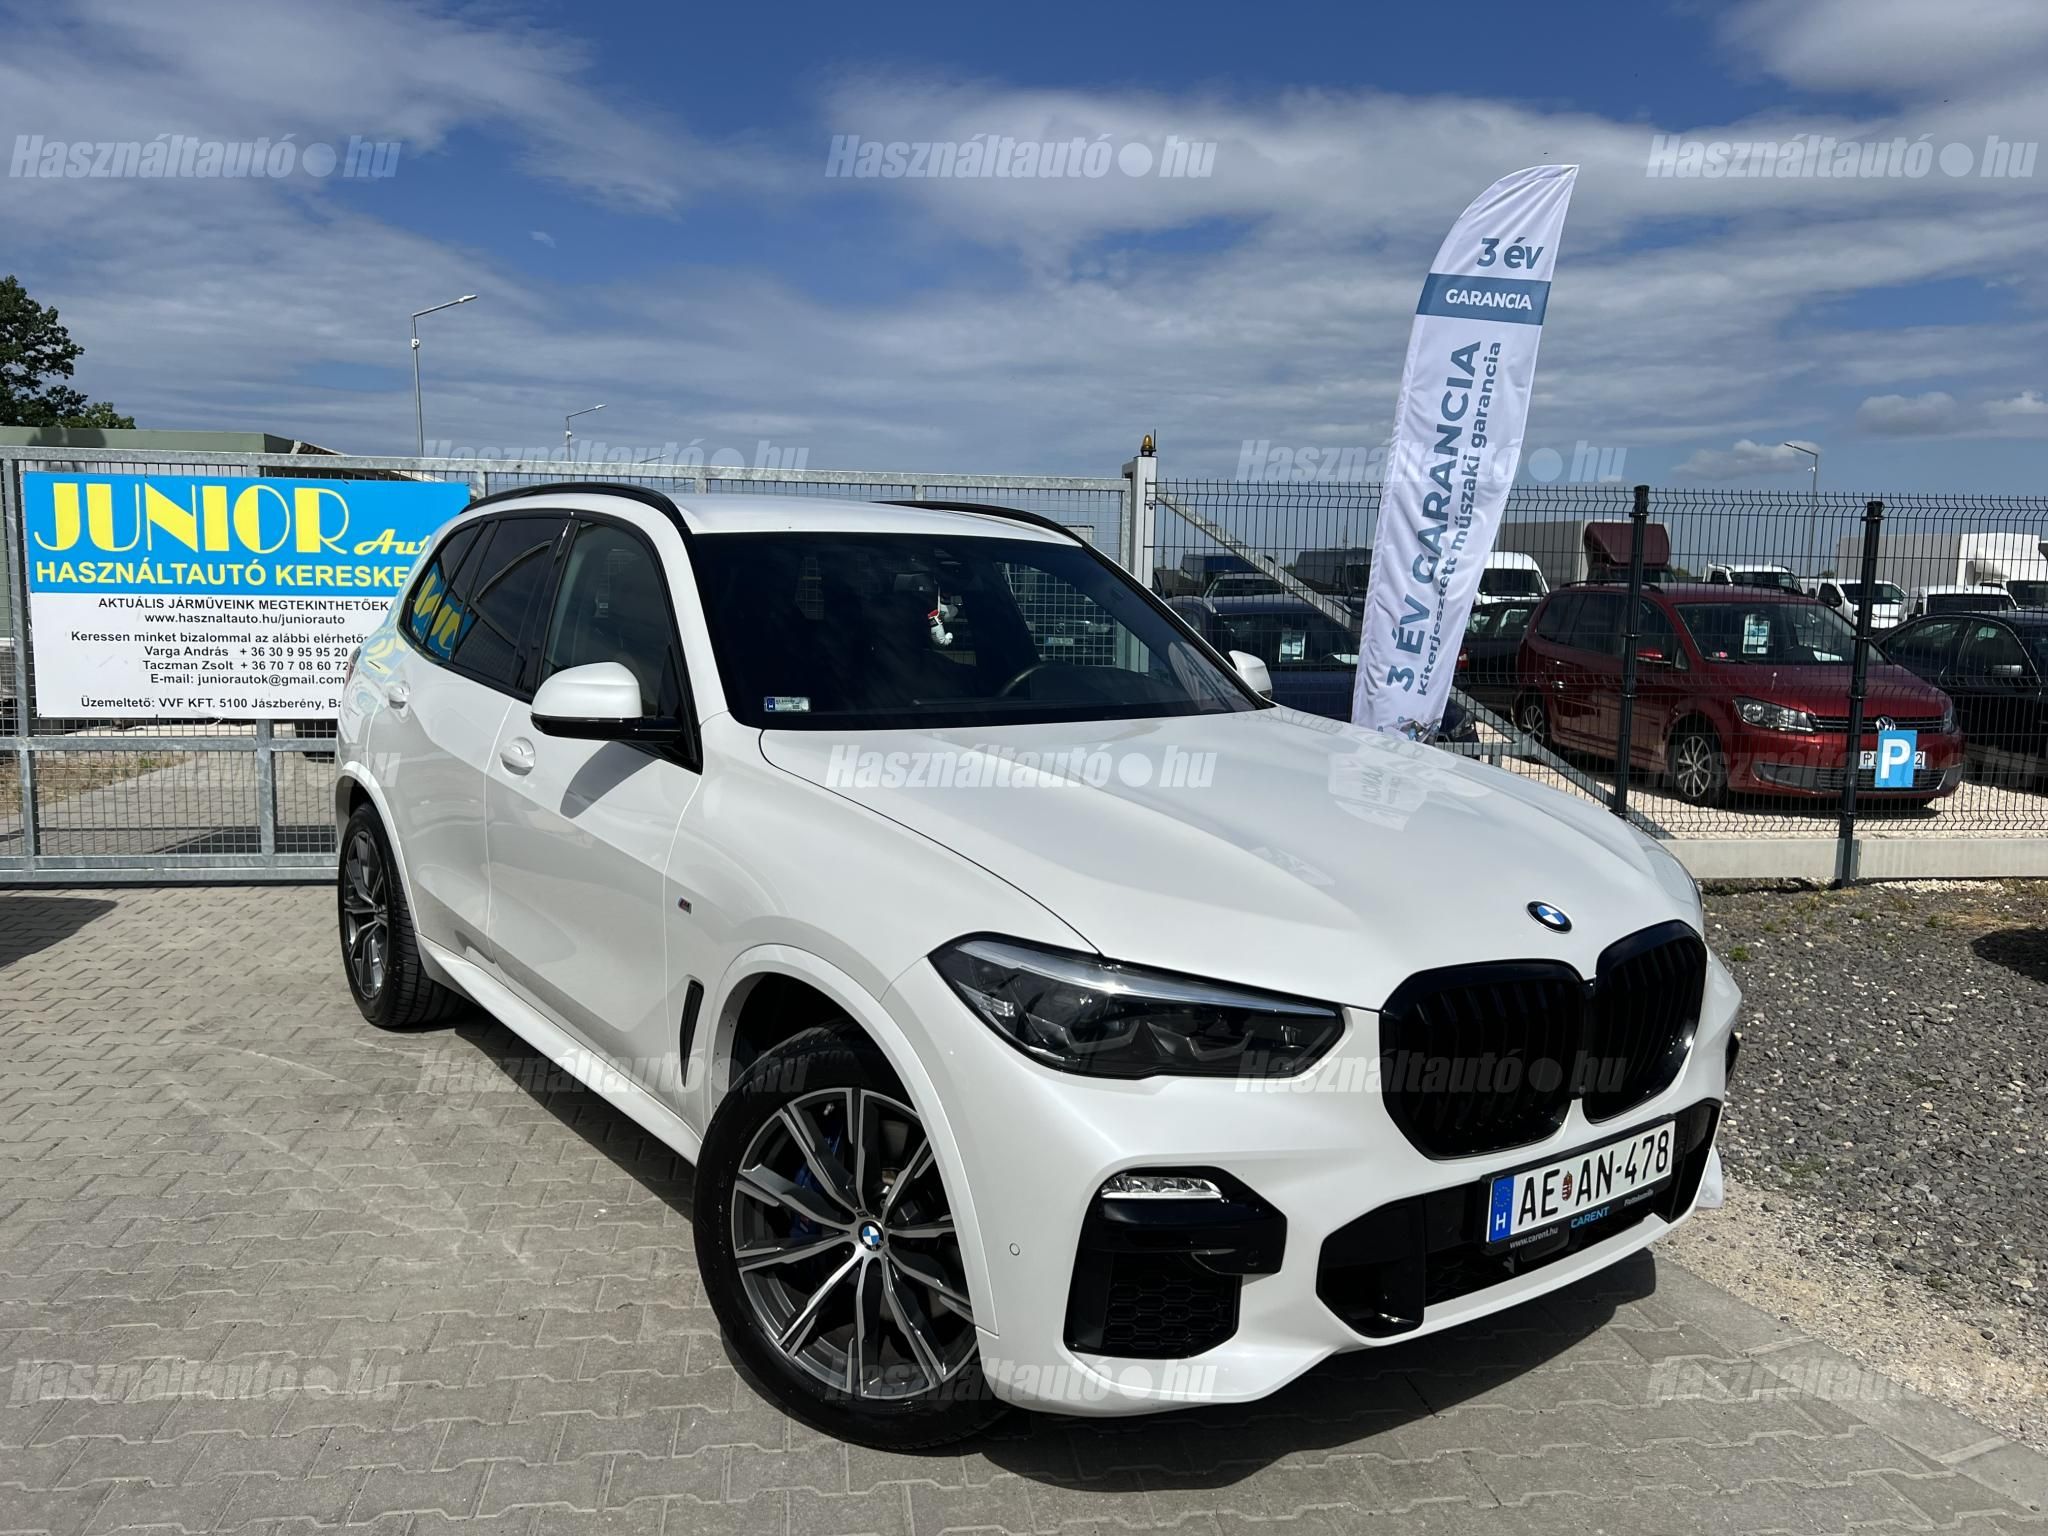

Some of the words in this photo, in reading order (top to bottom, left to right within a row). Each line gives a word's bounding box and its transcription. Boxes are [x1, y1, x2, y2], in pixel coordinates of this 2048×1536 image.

[1477, 238, 1500, 267] 3
[1503, 236, 1544, 269] év
[1445, 288, 1532, 310] GARANCIA
[1450, 454, 1480, 551] műszaki
[1471, 342, 1502, 449] garancia
[1412, 341, 1481, 584] GARANCIA
[33, 482, 349, 554] JUNIOR
[36, 557, 267, 586] HASZNÁLTAUTÓ
[275, 564, 409, 588] KERESKE
[98, 596, 165, 609] AKTUÁLIS
[144, 613, 346, 626] www.hasznaltauto.hu/juniorauto
[1391, 594, 1430, 654] ÉV
[71, 631, 130, 642] Keressen
[134, 632, 177, 642] minket
[180, 632, 251, 643] bizalommal
[255, 635, 269, 643] az
[272, 632, 310, 644] alábbi
[144, 646, 180, 658] Varga
[183, 646, 229, 657] András
[251, 647, 265, 657] 36
[269, 647, 284, 657] 30
[287, 647, 294, 657] 9
[297, 648, 312, 657] 95
[316, 648, 331, 657] 95
[334, 648, 348, 657] 20
[142, 660, 198, 670] Taczman
[201, 660, 234, 670] Zsolt
[252, 661, 266, 670] 36
[270, 661, 284, 671] 70
[288, 661, 295, 671] 7
[299, 661, 313, 671] 08
[317, 661, 331, 671] 60
[336, 661, 348, 671] 72
[150, 673, 194, 684] E-mail:
[197, 674, 345, 687] juniorautok@gmail.com
[1386, 665, 1414, 692] 3
[81, 694, 155, 708] Üzemeltető:
[159, 698, 184, 708] VVF
[188, 698, 216, 708] KFT.
[219, 698, 248, 708] 5100
[251, 698, 325, 710] Jászberény,
[1880, 739, 1911, 779] P
[1495, 1212, 1506, 1231] H
[1509, 1226, 1559, 1249] www.carent.hu
[1570, 1206, 1610, 1229] CARENT
